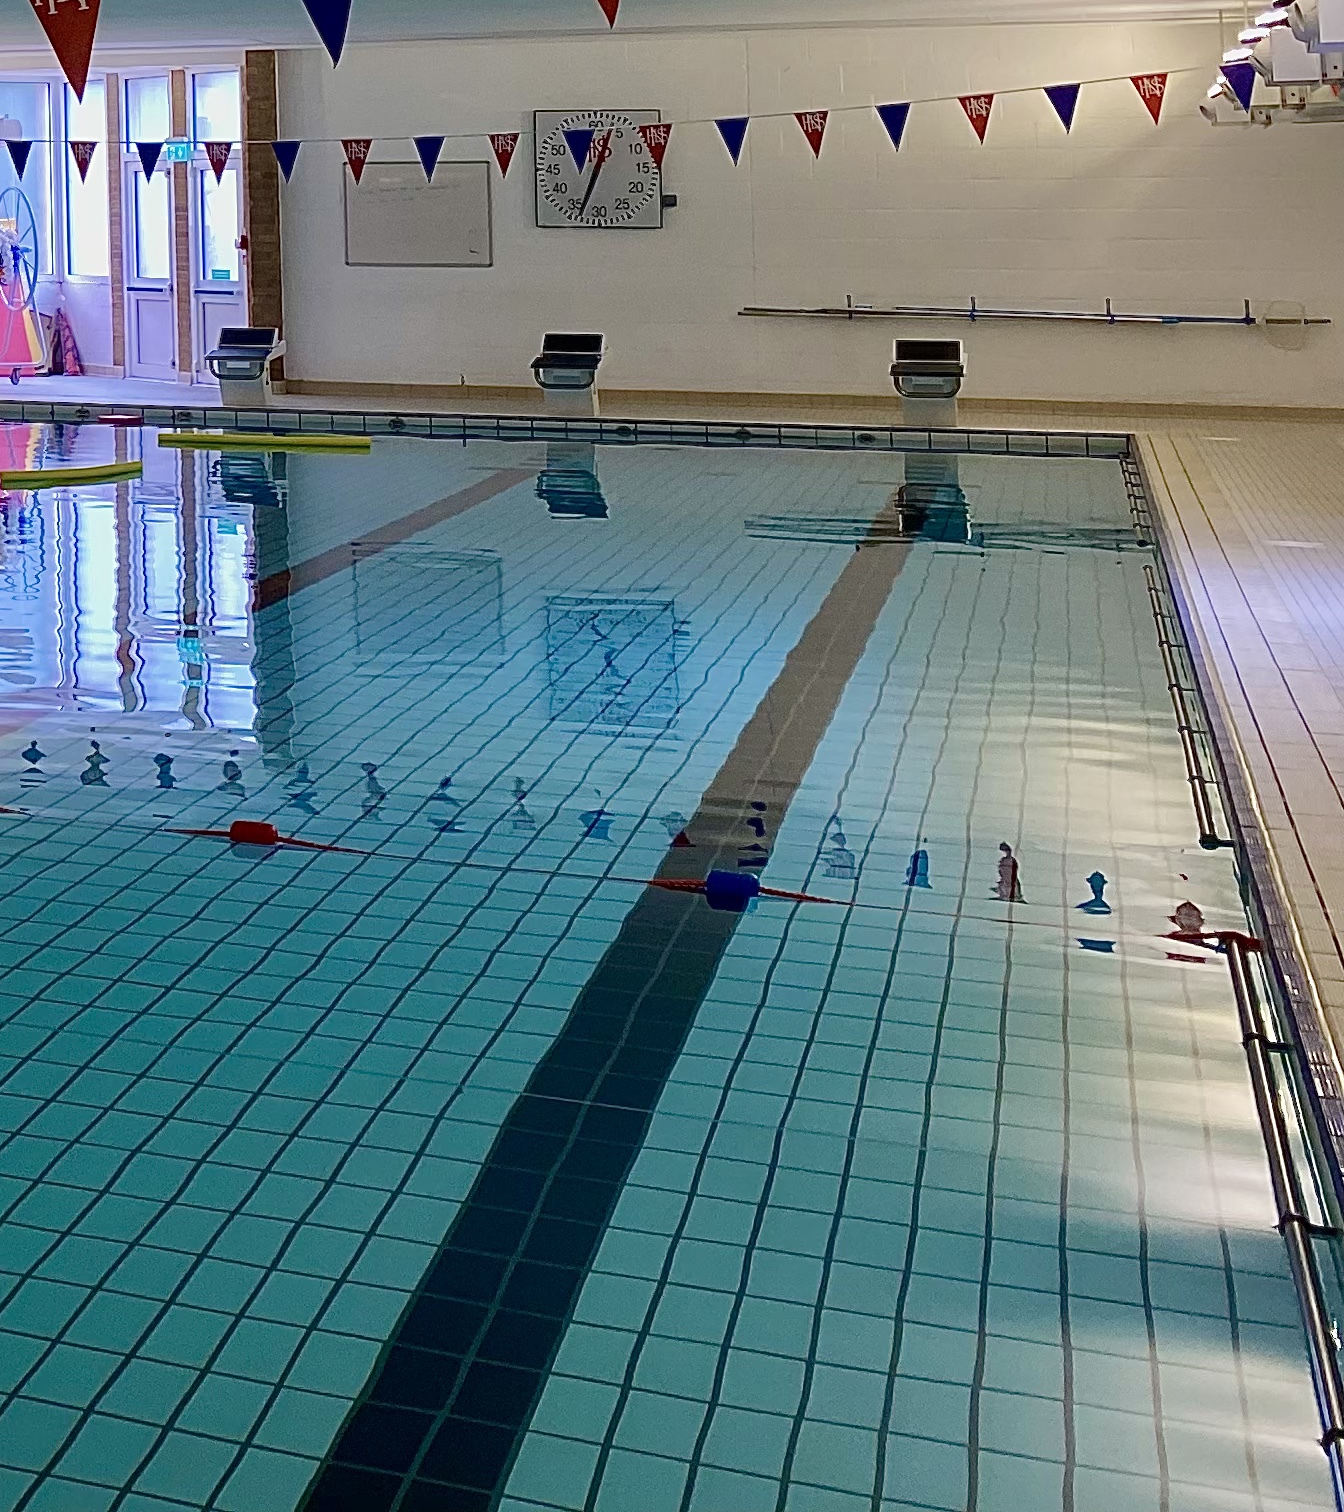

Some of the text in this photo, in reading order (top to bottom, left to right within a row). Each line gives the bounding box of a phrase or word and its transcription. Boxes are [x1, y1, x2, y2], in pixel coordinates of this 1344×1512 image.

[616, 128, 623, 138] 5
[551, 145, 566, 156] 50
[629, 143, 642, 155] 10
[546, 164, 560, 175] 45
[636, 162, 650, 173] 15
[553, 183, 567, 194] 40
[628, 182, 643, 193] 20
[568, 198, 582, 210] 35
[615, 198, 630, 209] 25
[592, 206, 607, 217] 30
